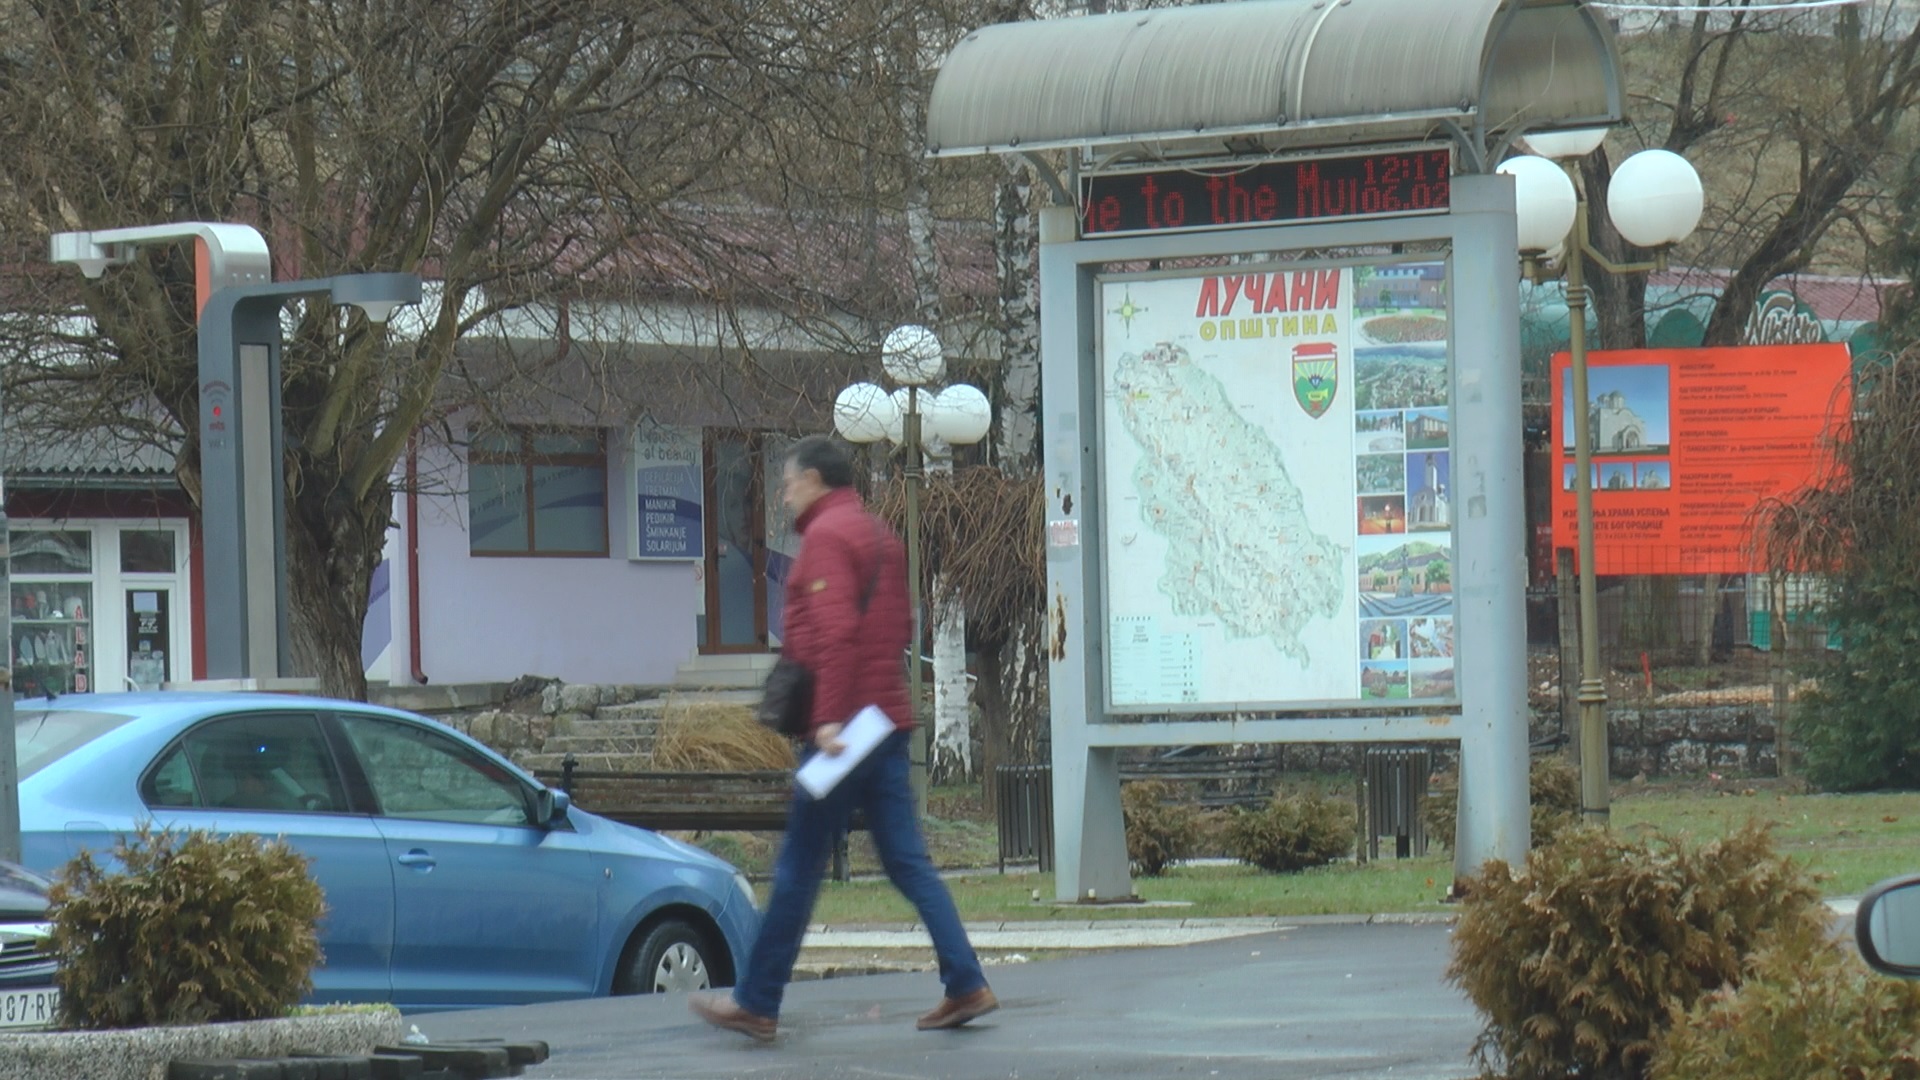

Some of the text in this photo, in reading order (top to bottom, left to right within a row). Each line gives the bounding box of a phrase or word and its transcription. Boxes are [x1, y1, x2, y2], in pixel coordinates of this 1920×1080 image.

[1363, 152, 1448, 185] 12:17
[1140, 175, 1186, 229] to
[1205, 172, 1279, 225] the
[1196, 268, 1341, 318] ЛУЧАНИ
[1199, 314, 1338, 342] ОПШТИНА
[645, 499, 676, 511] MANIKIR
[645, 512, 675, 525] PEDIKIR
[645, 525, 687, 540] ŠMINKANJE
[646, 540, 687, 554] SOLARIJUM
